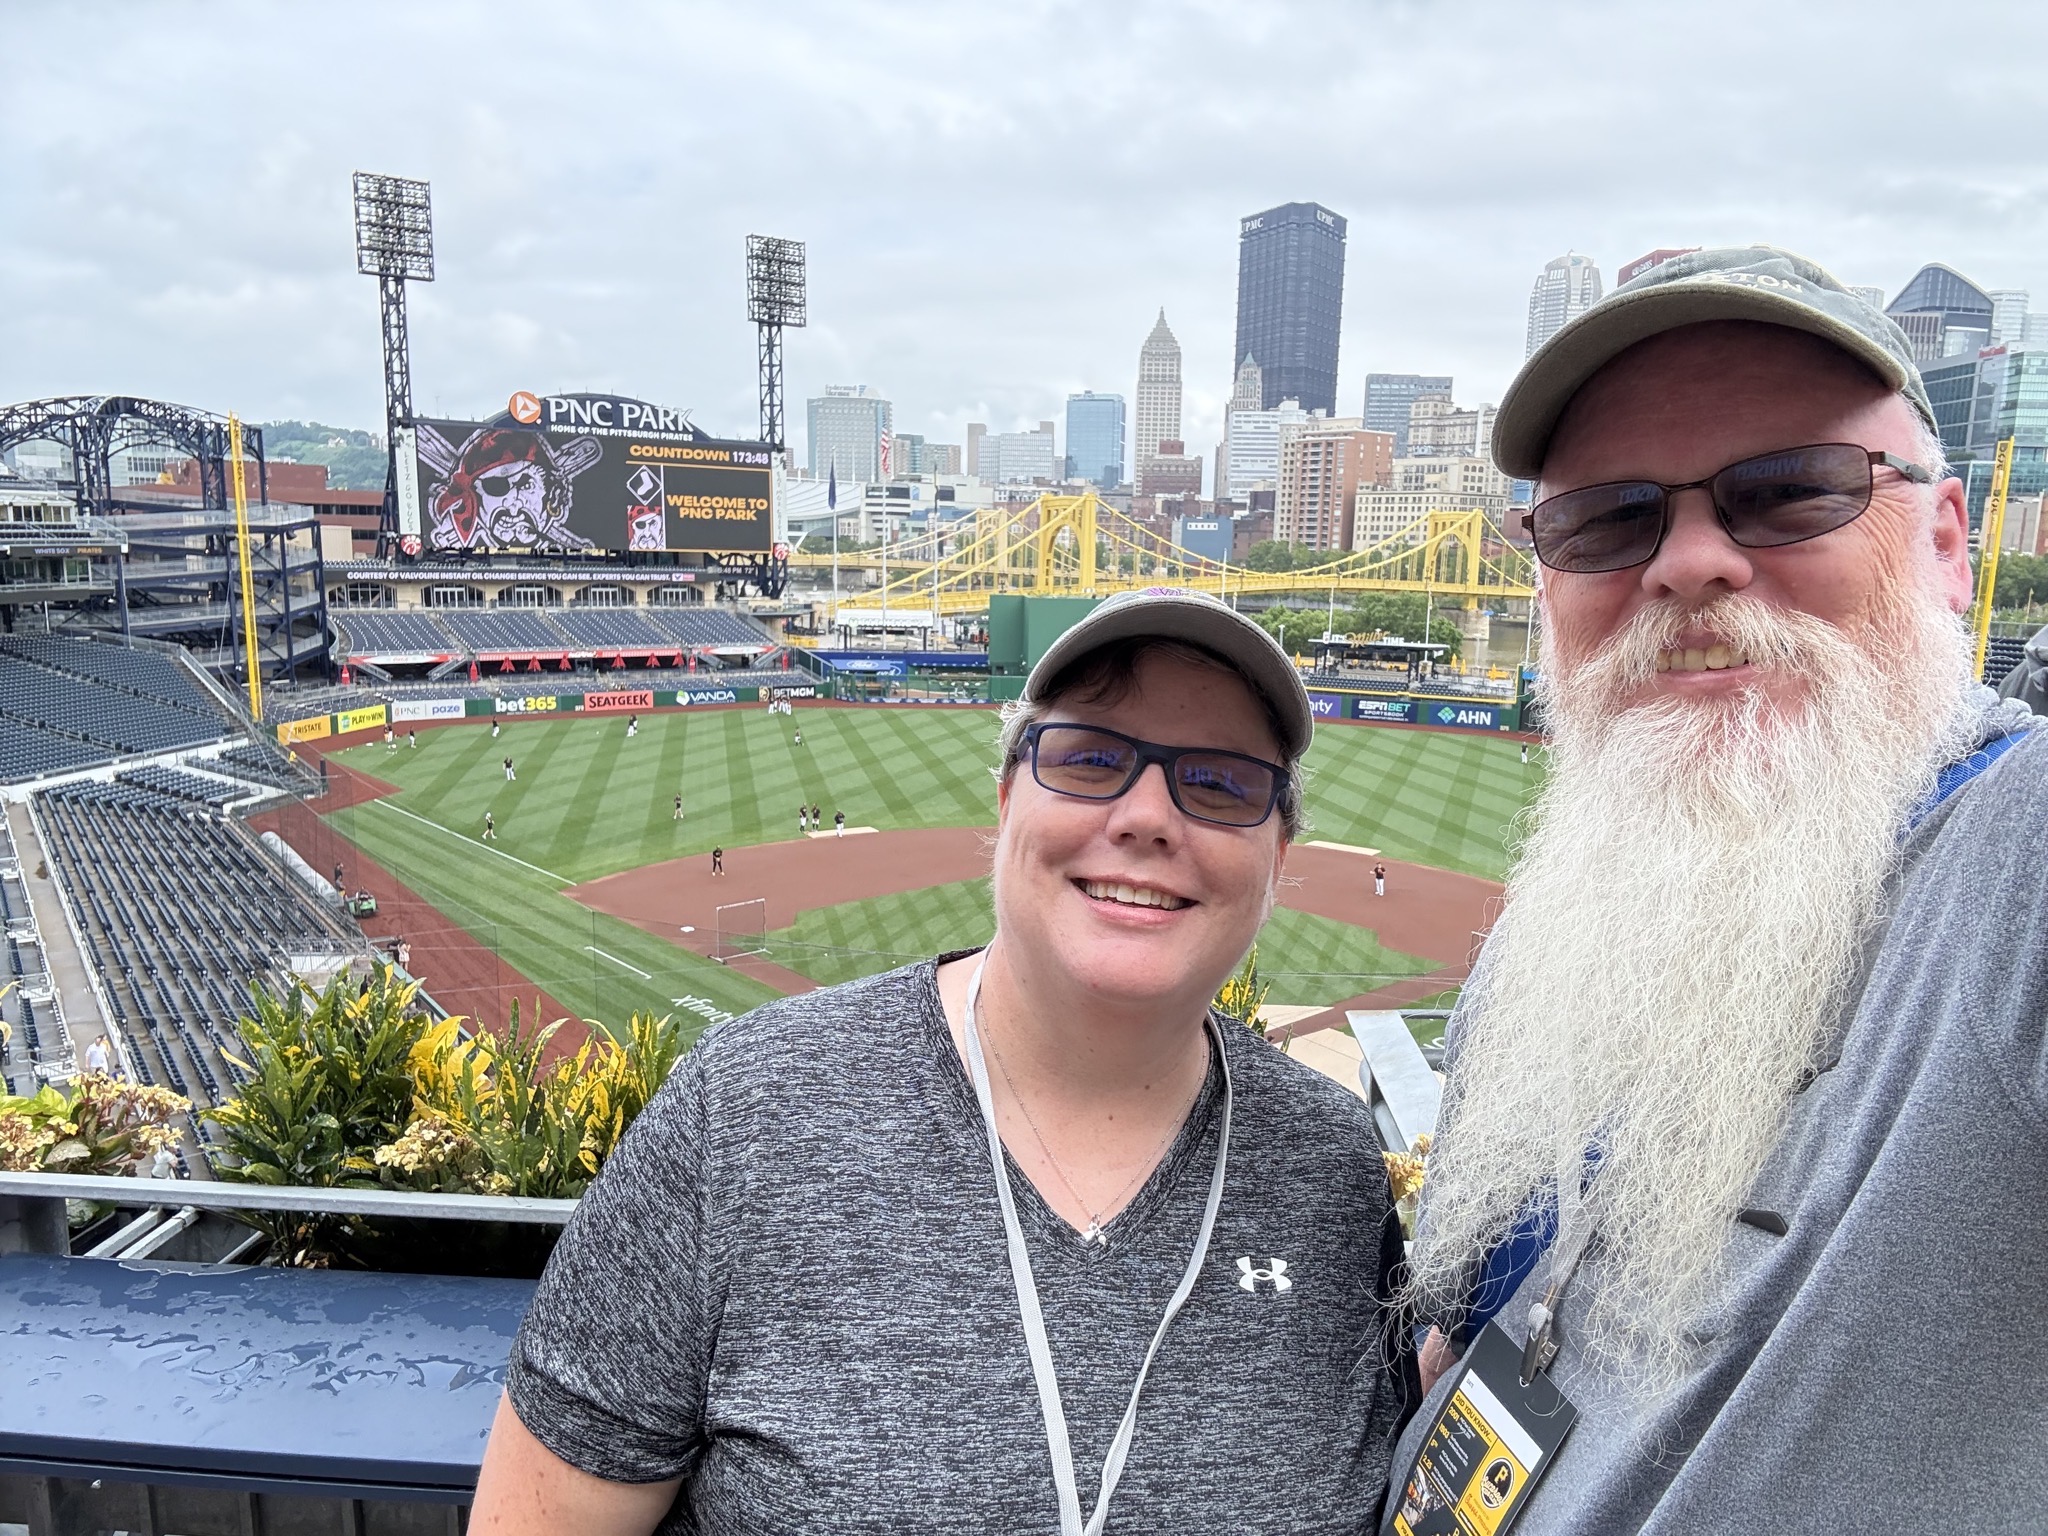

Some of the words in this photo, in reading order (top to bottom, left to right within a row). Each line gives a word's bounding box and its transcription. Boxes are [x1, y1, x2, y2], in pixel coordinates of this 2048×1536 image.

[1241, 217, 1264, 233] UPMC
[1316, 209, 1335, 227] UPMC
[546, 397, 613, 426] PNC
[619, 403, 694, 432] PARK
[551, 425, 576, 434] HOME
[578, 426, 590, 435] OF
[591, 427, 608, 436] THE
[609, 429, 660, 440] PITTSBURGH
[661, 432, 693, 442] PIRATES
[630, 445, 729, 462] COUNTDOWN
[666, 494, 747, 509] WELCOME
[748, 498, 768, 510] TO
[679, 507, 713, 520] PNC
[716, 508, 757, 521] PARK
[347, 572, 388, 580] COURTESY
[388, 572, 399, 580] OF
[400, 572, 440, 580] VALVOLINE
[440, 572, 471, 580] INSTANT
[472, 572, 483, 580] OIL
[484, 572, 516, 580] CHANGE!
[517, 573, 547, 581] SERVICE
[547, 573, 561, 581] YOU
[562, 573, 577, 581] CAN
[593, 573, 621, 581] EXPERTS
[621, 573, 635, 581] YOU
[636, 573, 650, 581] CAN
[1345, 631, 1390, 648] Miller
[1382, 637, 1405, 645] TIME
[689, 690, 736, 702] VANDA
[773, 686, 815, 699] BETMGM
[495, 696, 557, 713] bet365
[589, 693, 648, 709] SEATGEEK
[1309, 699, 1334, 715] nity
[400, 706, 420, 716] PNC
[432, 704, 460, 715] paze
[1364, 710, 1405, 718] SPORTSBOOK
[352, 714, 365, 726] PLAY
[1456, 710, 1491, 726] AHN
[293, 722, 322, 735] TRISTATE
[671, 994, 735, 1023] xfinit
[1448, 1406, 1460, 1422] 2001
[1455, 1394, 1466, 1407] DID
[1464, 1405, 1475, 1419] YOU
[1473, 1417, 1493, 1443] KNOW...
